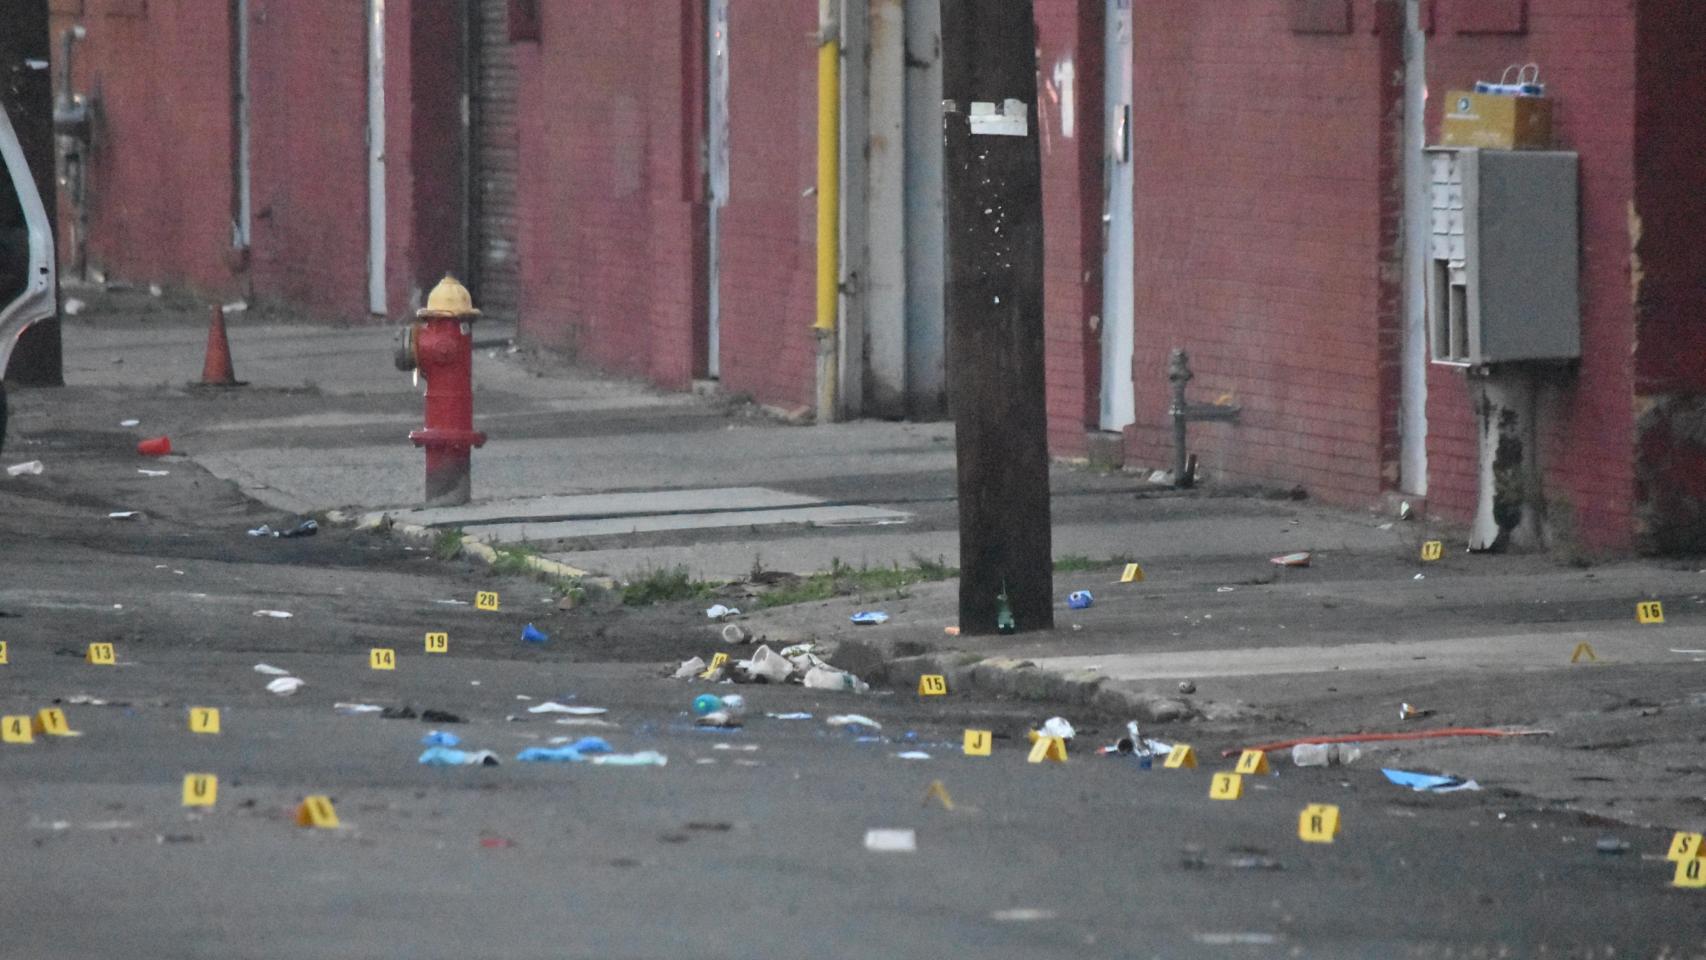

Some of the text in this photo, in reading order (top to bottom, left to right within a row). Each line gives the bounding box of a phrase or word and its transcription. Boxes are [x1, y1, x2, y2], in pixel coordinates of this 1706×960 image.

[480, 594, 495, 607] 28
[1642, 604, 1660, 618] 16
[430, 635, 445, 648] 19
[94, 645, 111, 660] 13
[375, 652, 391, 665] 14
[926, 678, 942, 690] 15
[200, 711, 209, 727] 7
[11, 720, 21, 735] 4
[972, 734, 982, 749] J
[194, 779, 206, 797] U
[1220, 777, 1229, 793] 3
[1311, 815, 1323, 834] R
[1678, 836, 1692, 854] S
